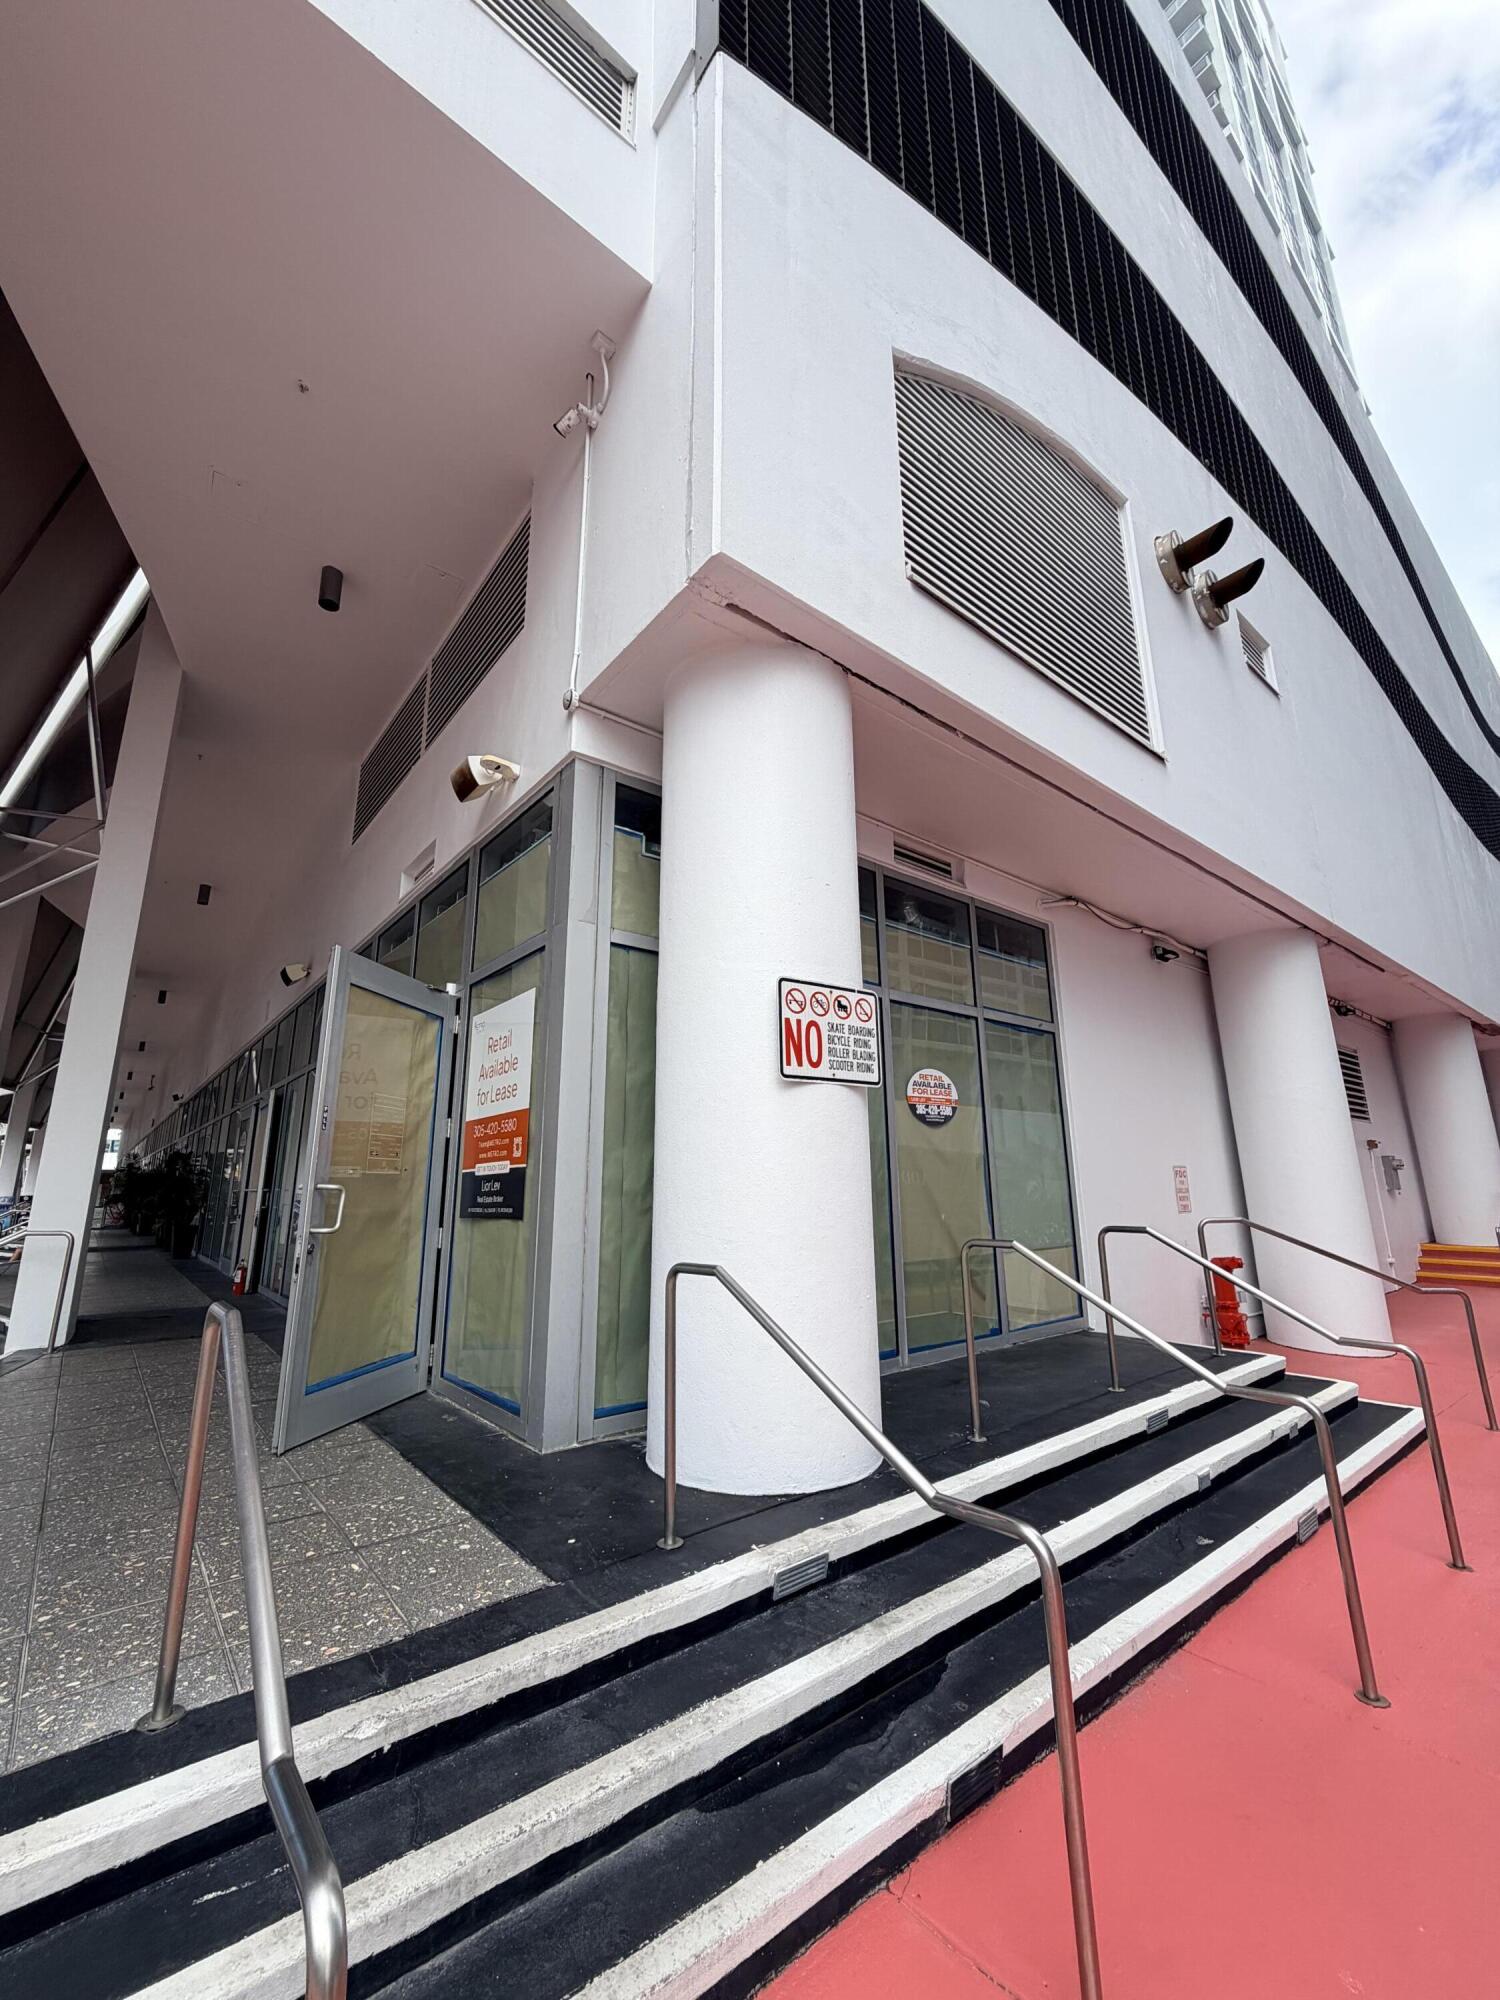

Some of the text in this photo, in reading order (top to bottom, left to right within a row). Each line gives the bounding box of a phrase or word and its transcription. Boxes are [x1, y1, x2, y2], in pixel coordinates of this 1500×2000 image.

[827, 1022, 875, 1038] SKATE BOARDING
[488, 1028, 513, 1055] Retail
[784, 1017, 823, 1069] NO
[828, 1034, 871, 1049] BICYCLE RIDING
[828, 1046, 876, 1062] ROLLER BLADING
[478, 1053, 519, 1082] Available
[828, 1059, 874, 1074] SCOOTER RIDING
[912, 1080, 952, 1090] AVAILABLE
[918, 1073, 944, 1082] RETAIL
[477, 1083, 518, 1106] for Lease
[912, 1087, 952, 1097] FOR LEASE
[473, 1118, 517, 1138] 305-420-5580
[491, 1178, 501, 1191] Lev
